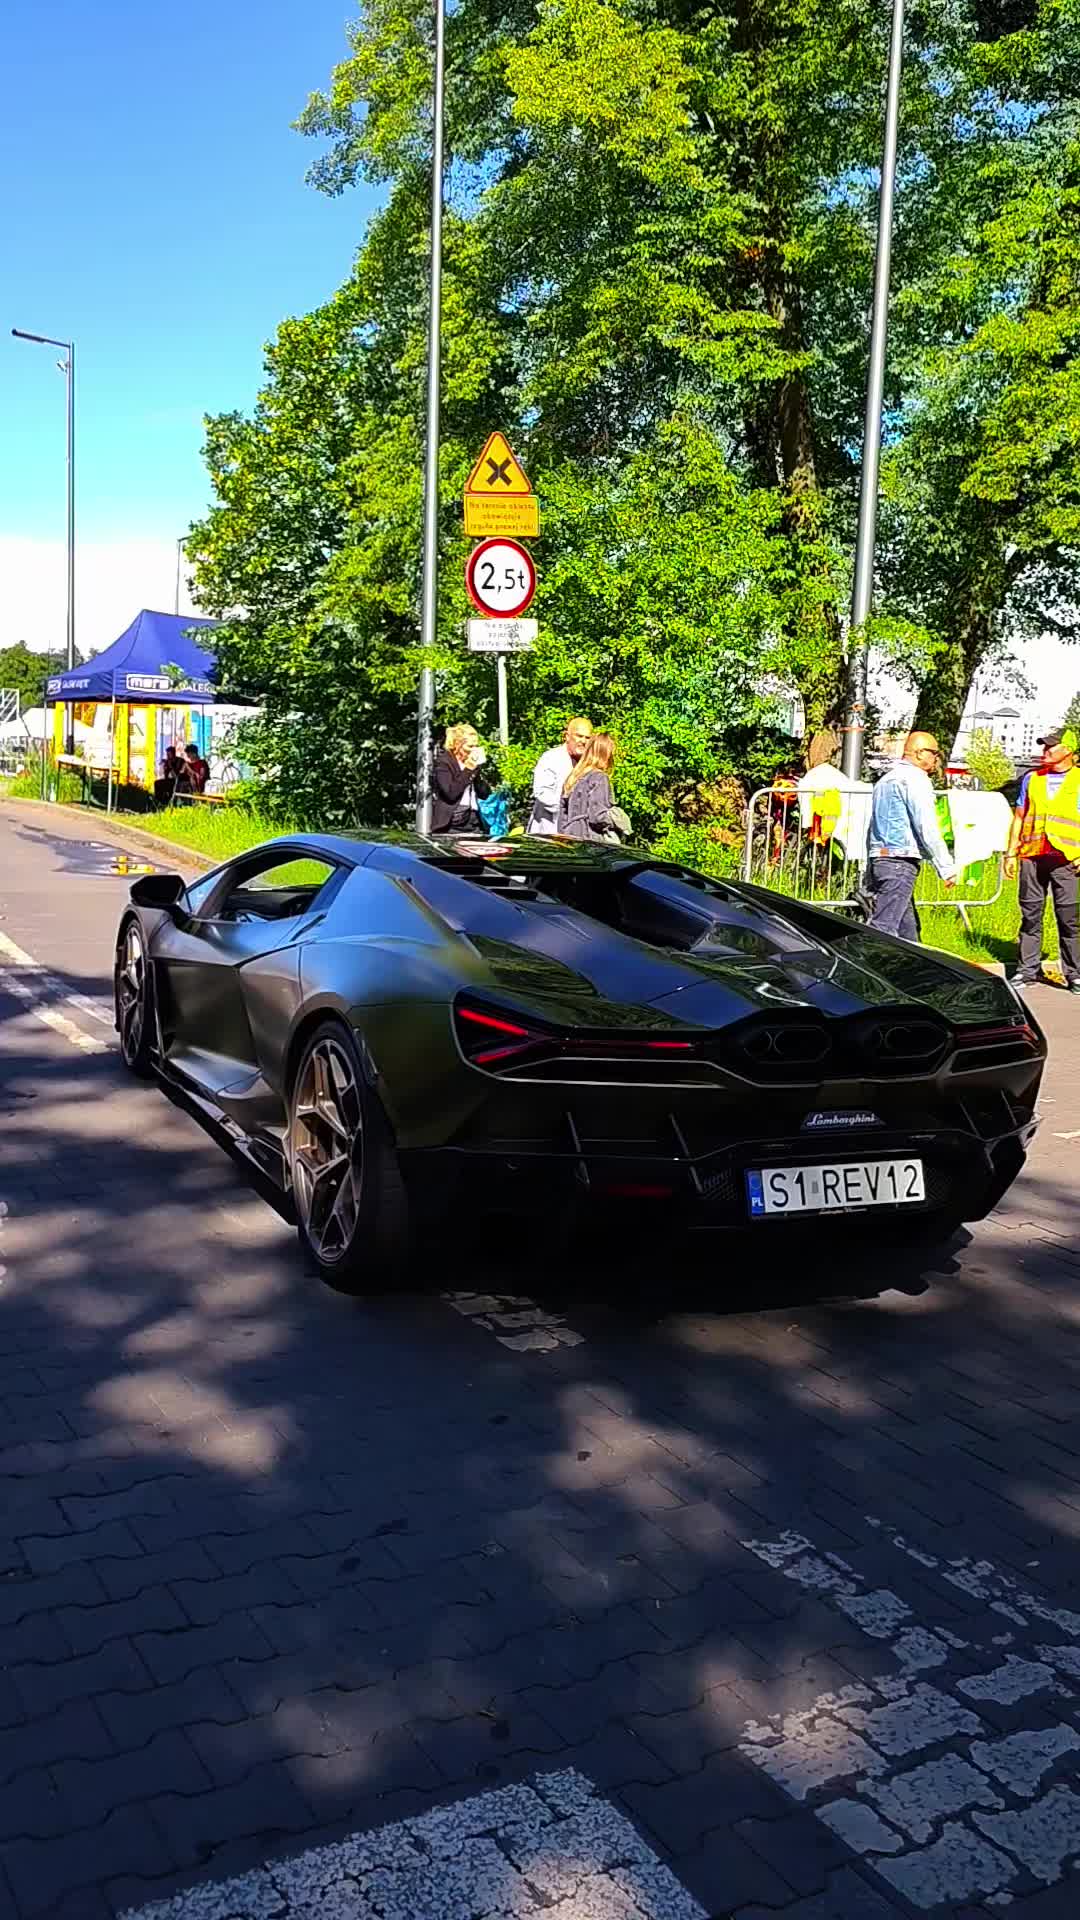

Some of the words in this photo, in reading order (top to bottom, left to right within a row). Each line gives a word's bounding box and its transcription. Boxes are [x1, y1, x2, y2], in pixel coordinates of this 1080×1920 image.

[480, 562, 526, 593] 2,5t
[806, 1113, 878, 1127] Lamborghini
[751, 1197, 764, 1207] PL
[769, 1171, 807, 1207] S1
[822, 1164, 920, 1205] REV12
